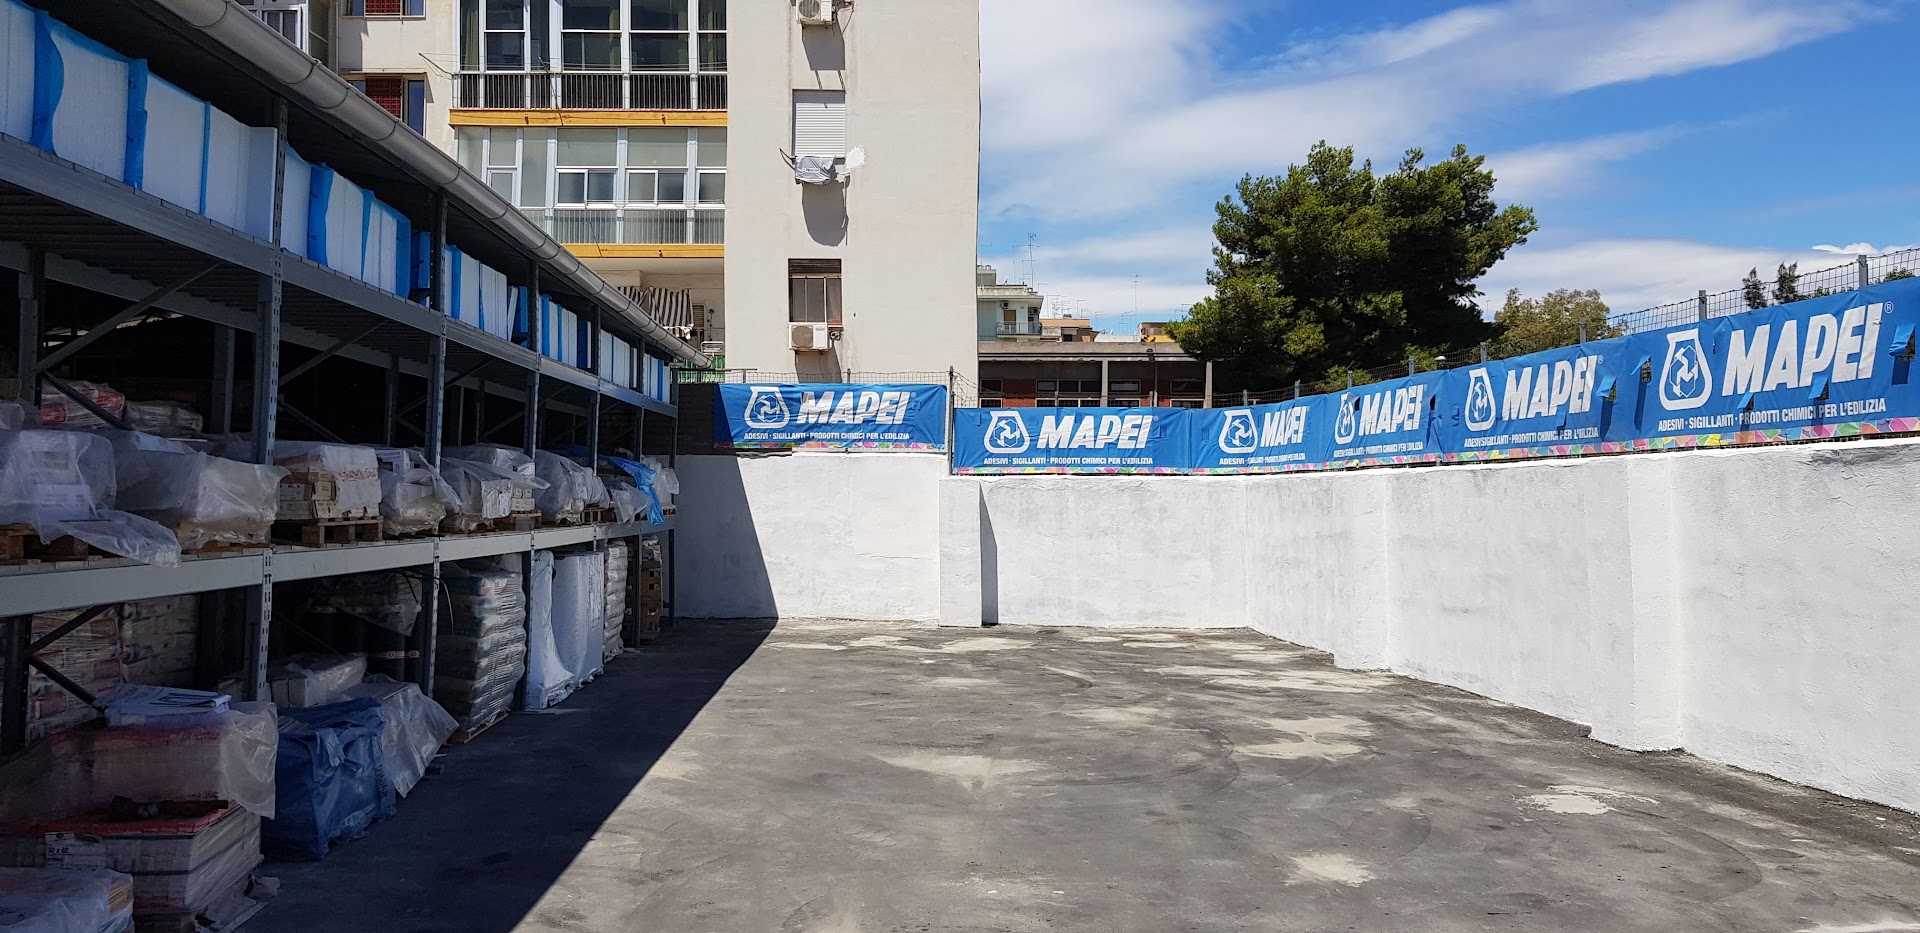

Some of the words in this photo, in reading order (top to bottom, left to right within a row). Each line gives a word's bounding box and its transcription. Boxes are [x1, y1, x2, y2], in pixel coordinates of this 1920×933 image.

[1721, 303, 1884, 396] MAPEI
[1502, 355, 1598, 421] MAPEI
[796, 391, 910, 425] MAPEI
[1358, 384, 1424, 437] MAPEI
[1658, 417, 1685, 433] ADESIVI
[1688, 413, 1734, 429] SIGILLANTI
[1739, 409, 1780, 426] PRODOTTI
[1782, 406, 1816, 422] CHIMICI
[1818, 403, 1838, 419] PER
[1839, 397, 1887, 416] L'EDILIZIA
[744, 432, 769, 440] ADESIVI
[772, 432, 806, 440] SIGILLANTI
[810, 432, 840, 440] PRODOTTI
[841, 432, 864, 440] CHIMICI
[866, 432, 879, 440] PER
[1036, 415, 1153, 449] MAPEI
[1511, 432, 1537, 444] PRODOTTI
[1219, 457, 1245, 465] ADESIVI
